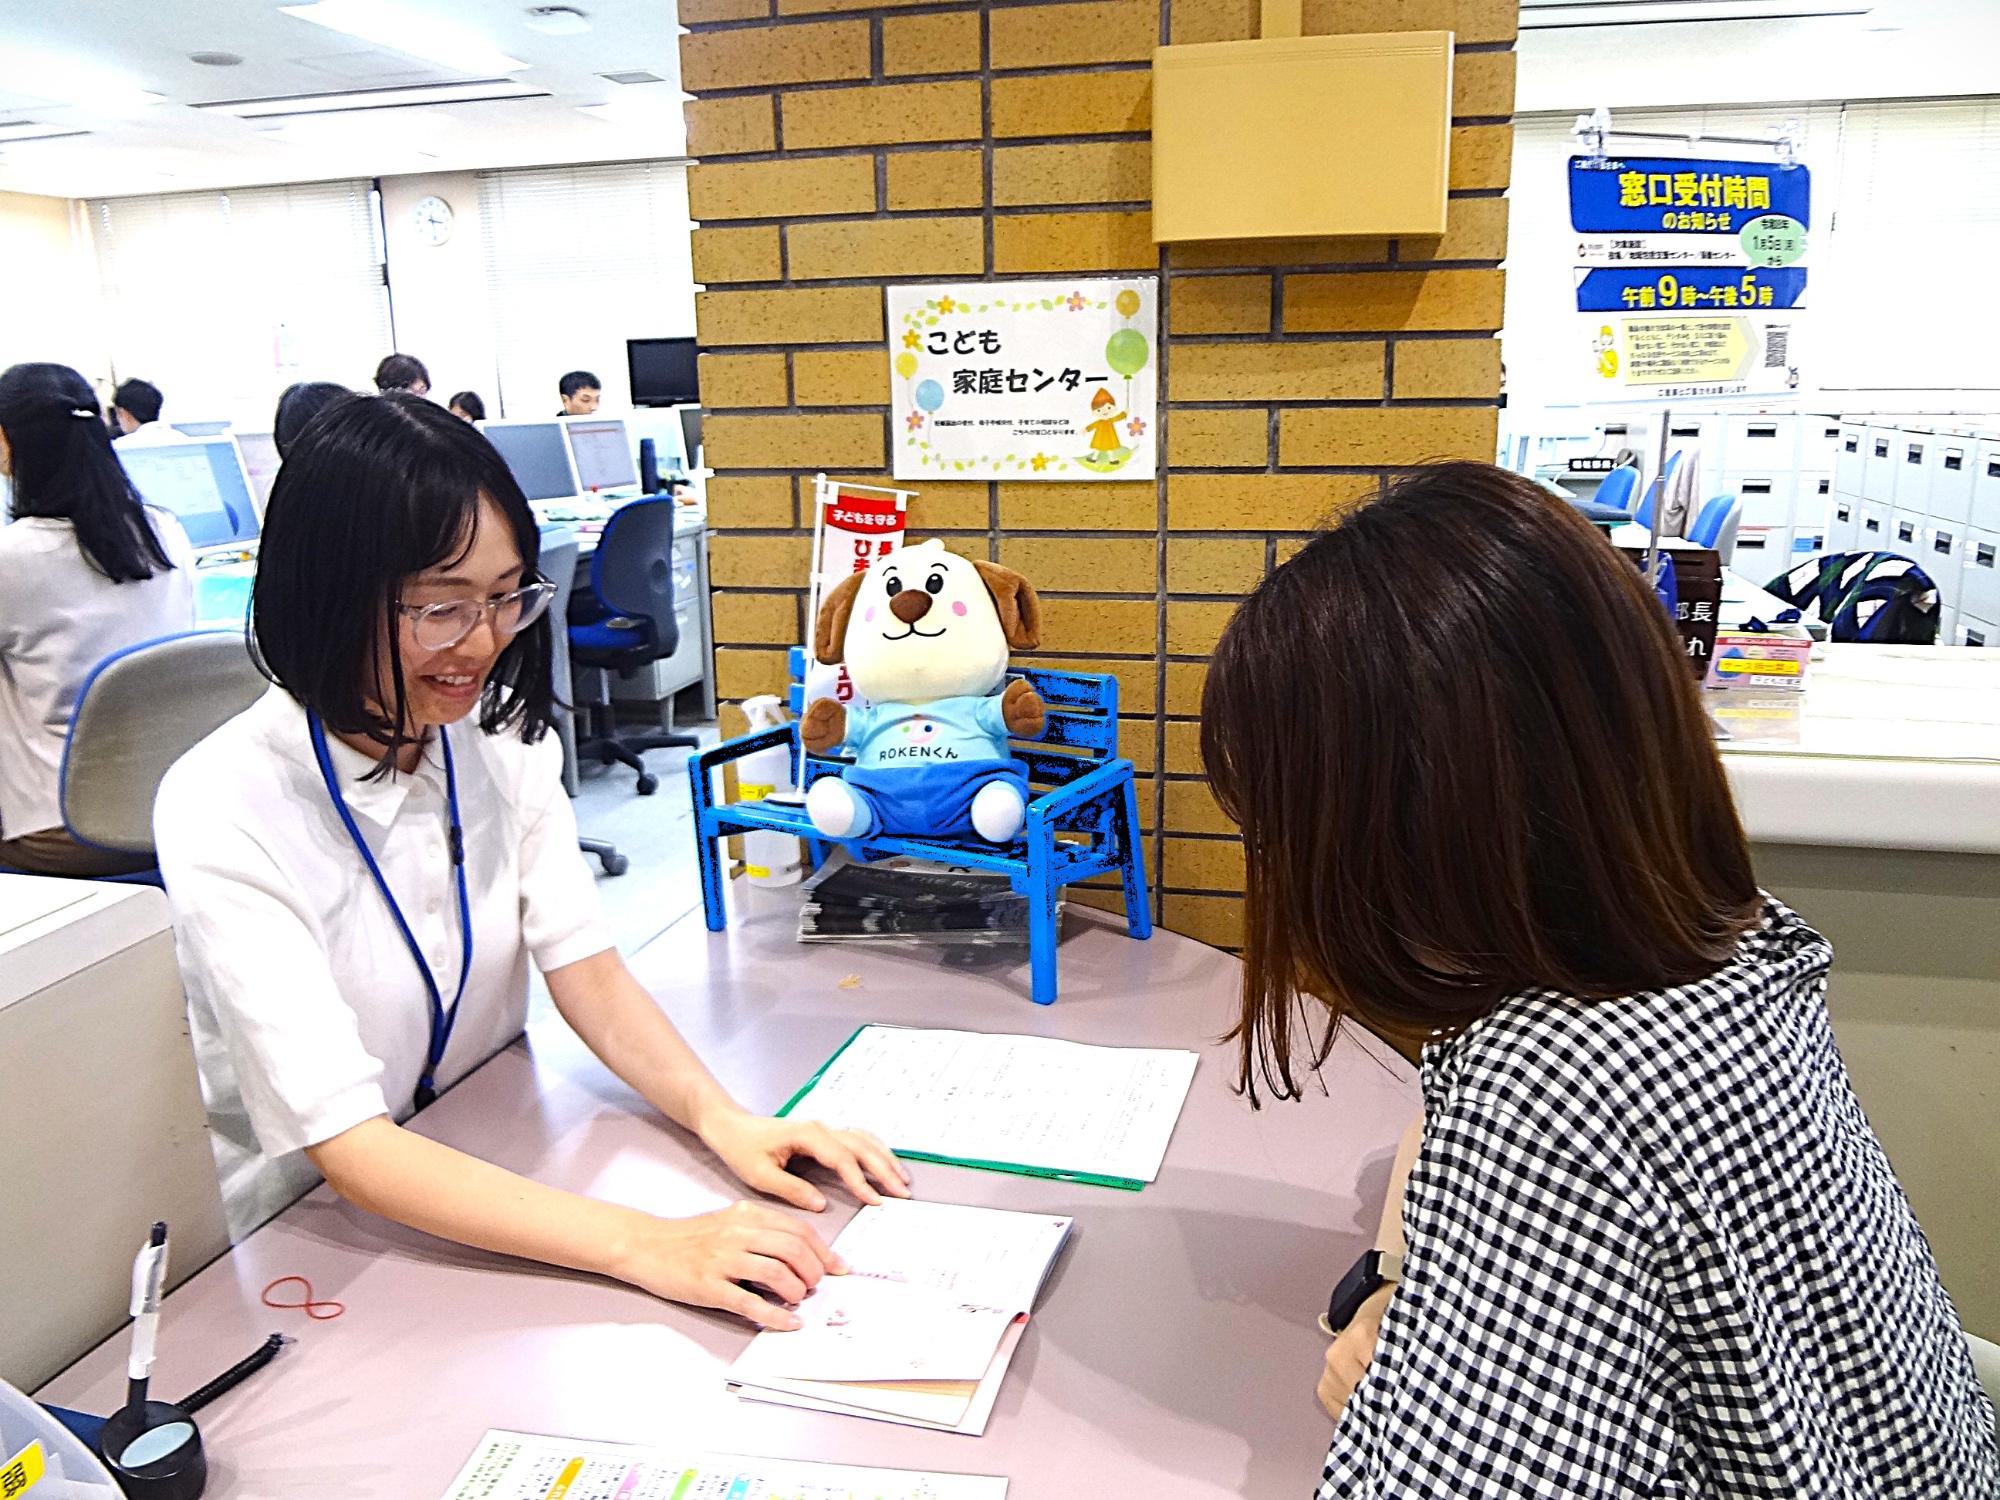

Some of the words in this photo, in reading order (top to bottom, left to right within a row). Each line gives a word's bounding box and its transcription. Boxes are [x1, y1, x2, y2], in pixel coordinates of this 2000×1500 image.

[1619, 171, 1770, 209] 窓口受付時間
[1662, 212, 1731, 230] のお知らせ
[927, 330, 1002, 355] こども
[953, 368, 1109, 394] 家庭センター
[833, 510, 897, 527] 子どもを守る
[880, 747, 959, 761] ROKENくん
